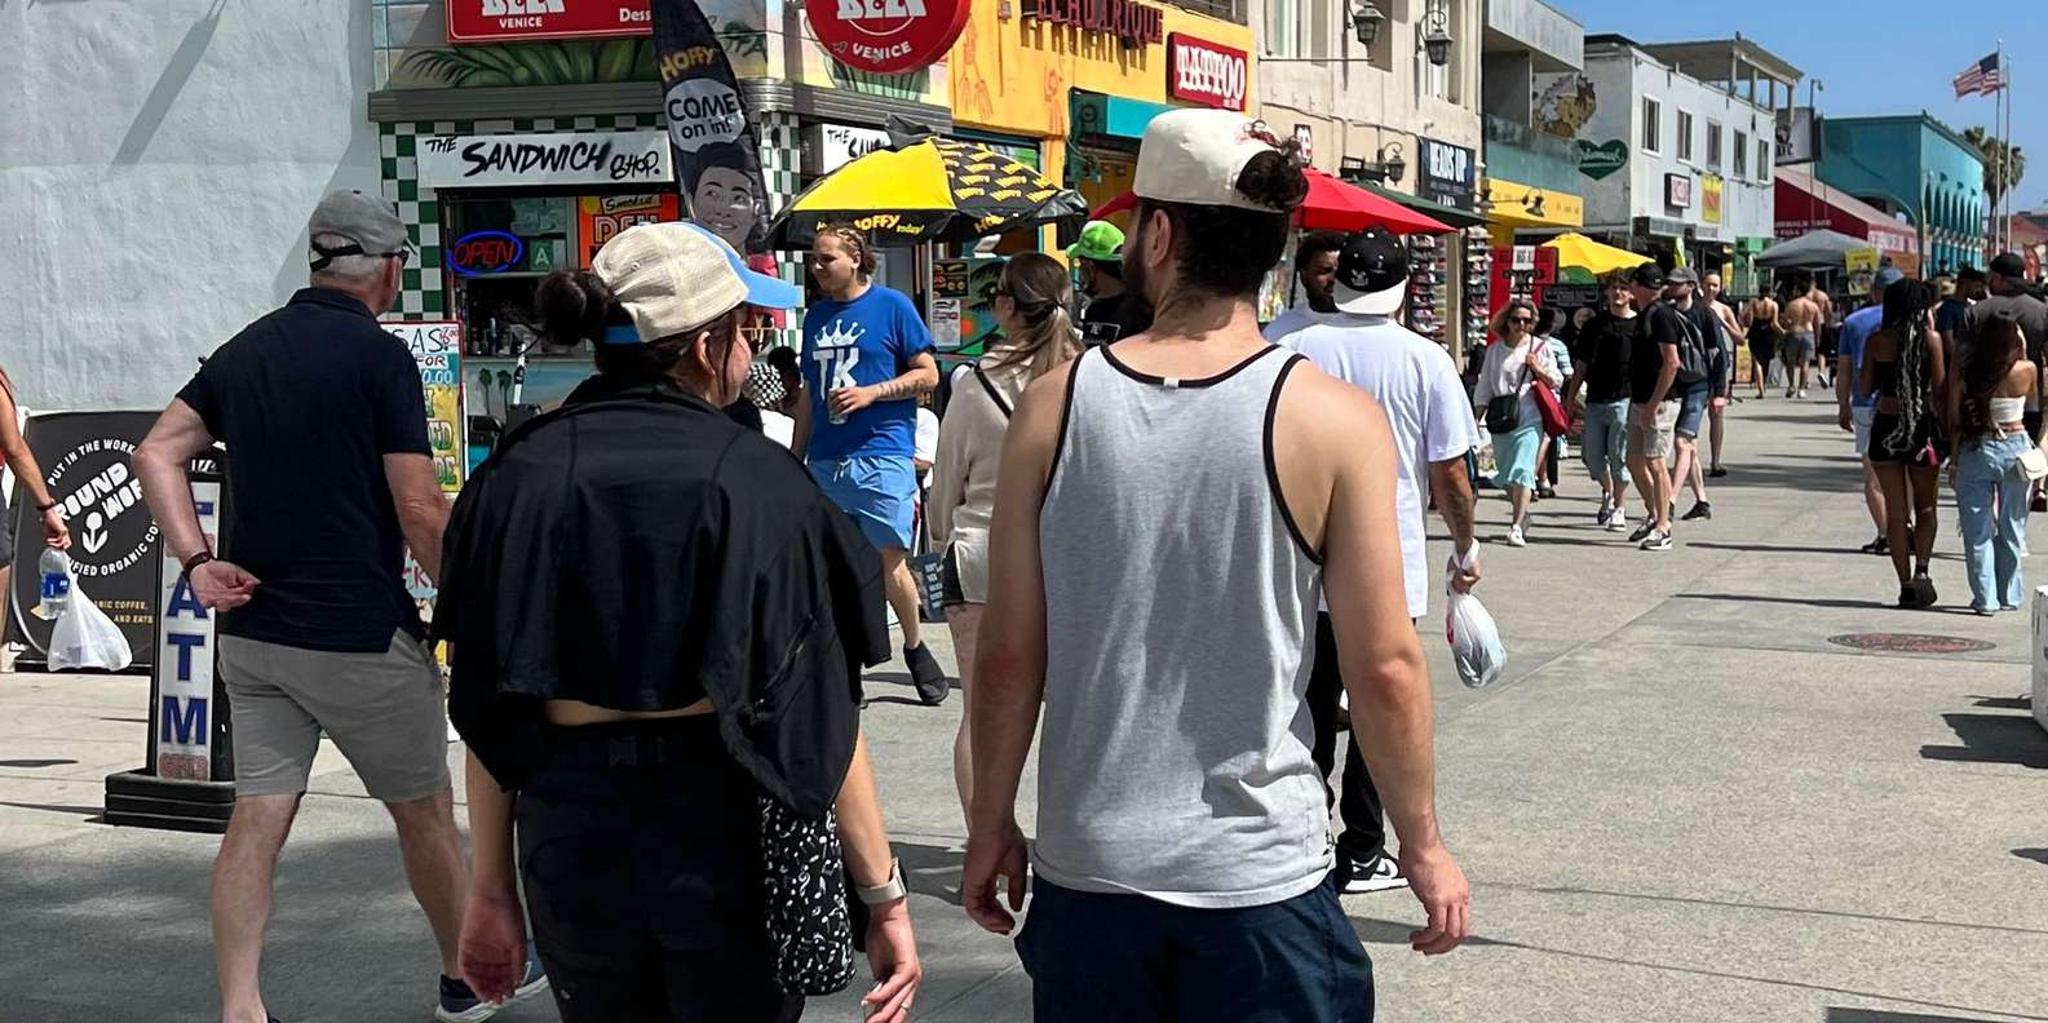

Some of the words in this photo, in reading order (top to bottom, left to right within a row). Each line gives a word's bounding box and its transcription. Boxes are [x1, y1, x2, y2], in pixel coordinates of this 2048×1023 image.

[499, 16, 543, 28] VENICE
[660, 46, 714, 82] HOFFY
[852, 41, 912, 60] VENICE
[1175, 45, 1245, 100] TATTOO
[668, 93, 738, 121] COME
[682, 124, 706, 139] on
[708, 117, 733, 134] in!
[827, 129, 850, 144] THE
[425, 136, 457, 153] THE
[462, 141, 613, 177] SANDWICH
[454, 240, 515, 266] OPEN
[535, 248, 550, 266] A
[812, 347, 859, 400] TK
[47, 461, 66, 487] PUT
[65, 451, 78, 466] IN
[77, 439, 100, 456] THE
[103, 438, 135, 455] WORK
[101, 542, 148, 576] ORGANIC
[161, 571, 208, 745] ATM
